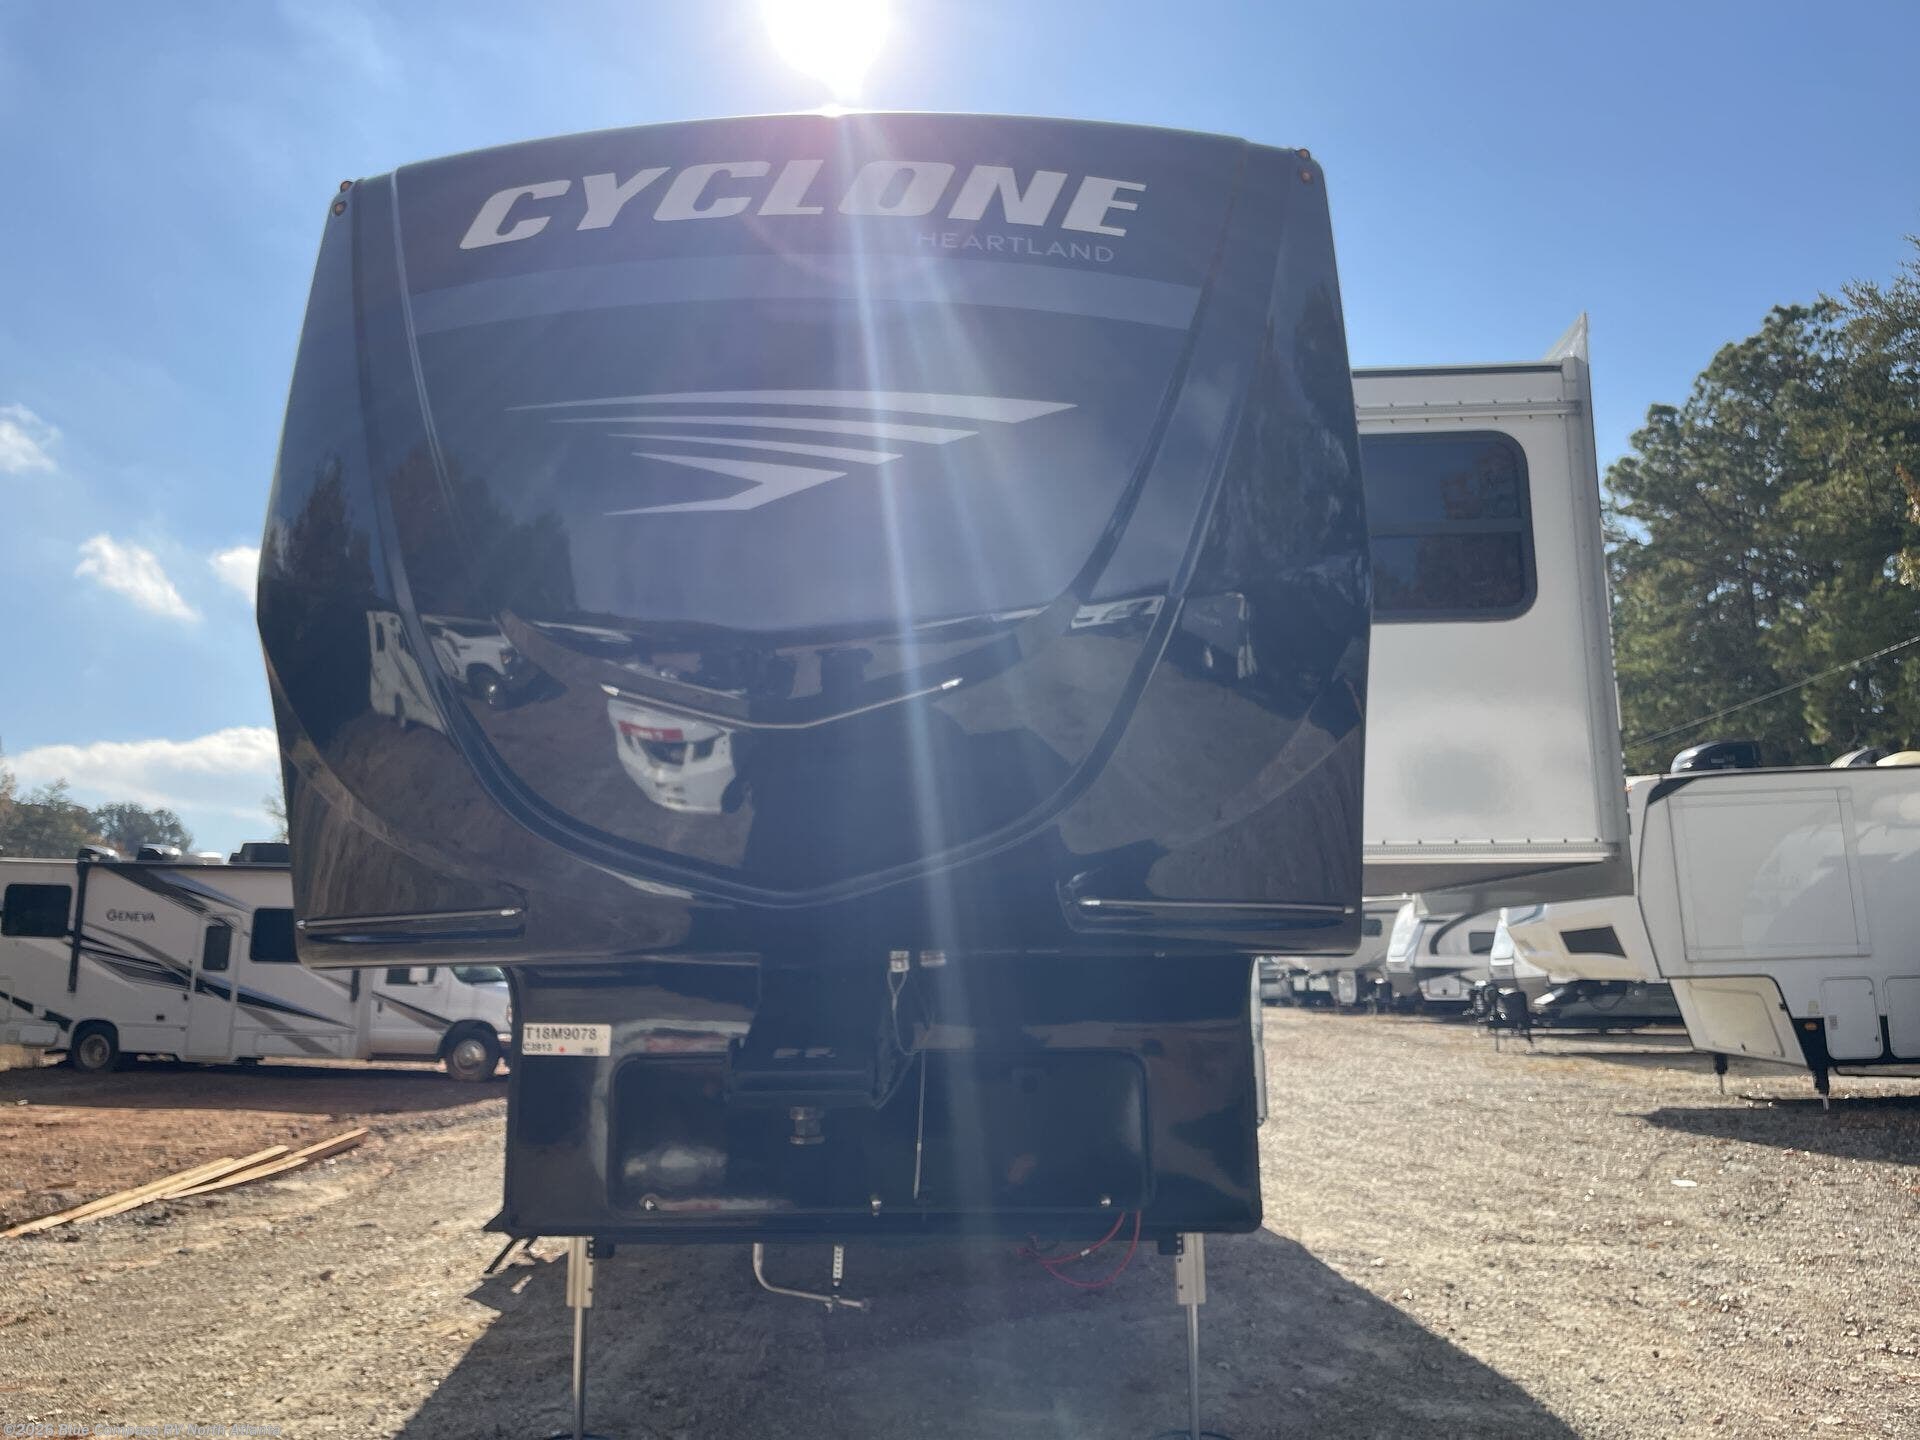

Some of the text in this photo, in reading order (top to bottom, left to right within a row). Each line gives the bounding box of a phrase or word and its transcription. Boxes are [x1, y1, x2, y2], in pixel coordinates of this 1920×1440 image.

[459, 159, 1147, 250] CYCLONE
[916, 231, 1115, 263] HEARTLAND
[106, 908, 156, 921] GENEVA
[524, 1027, 598, 1040] T18M9078
